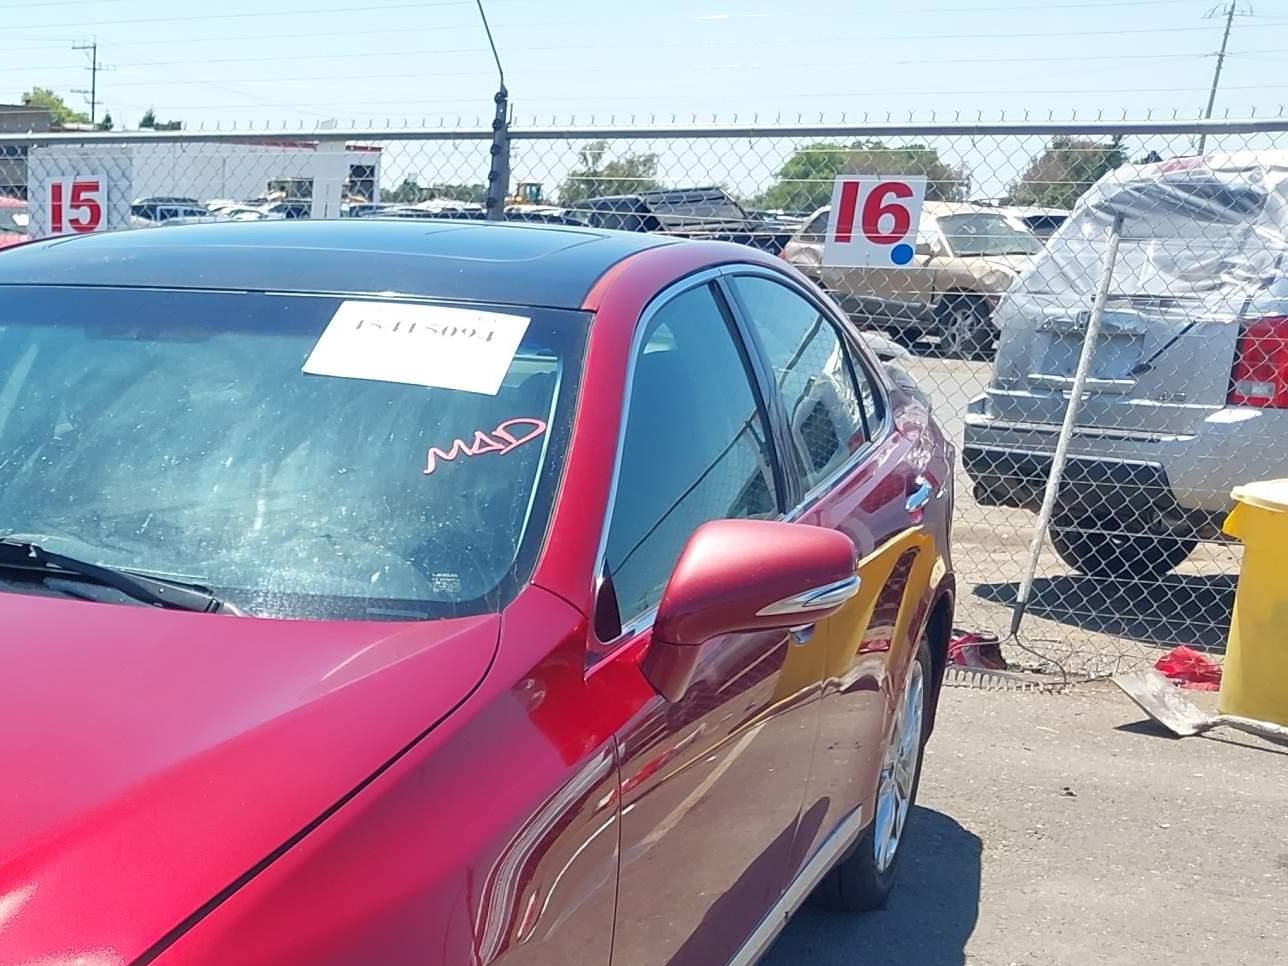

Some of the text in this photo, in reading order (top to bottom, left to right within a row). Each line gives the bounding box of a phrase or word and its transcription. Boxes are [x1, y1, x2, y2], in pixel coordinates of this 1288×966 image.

[50, 181, 101, 233] 15
[834, 181, 914, 245] 16
[423, 418, 547, 475] MAD
